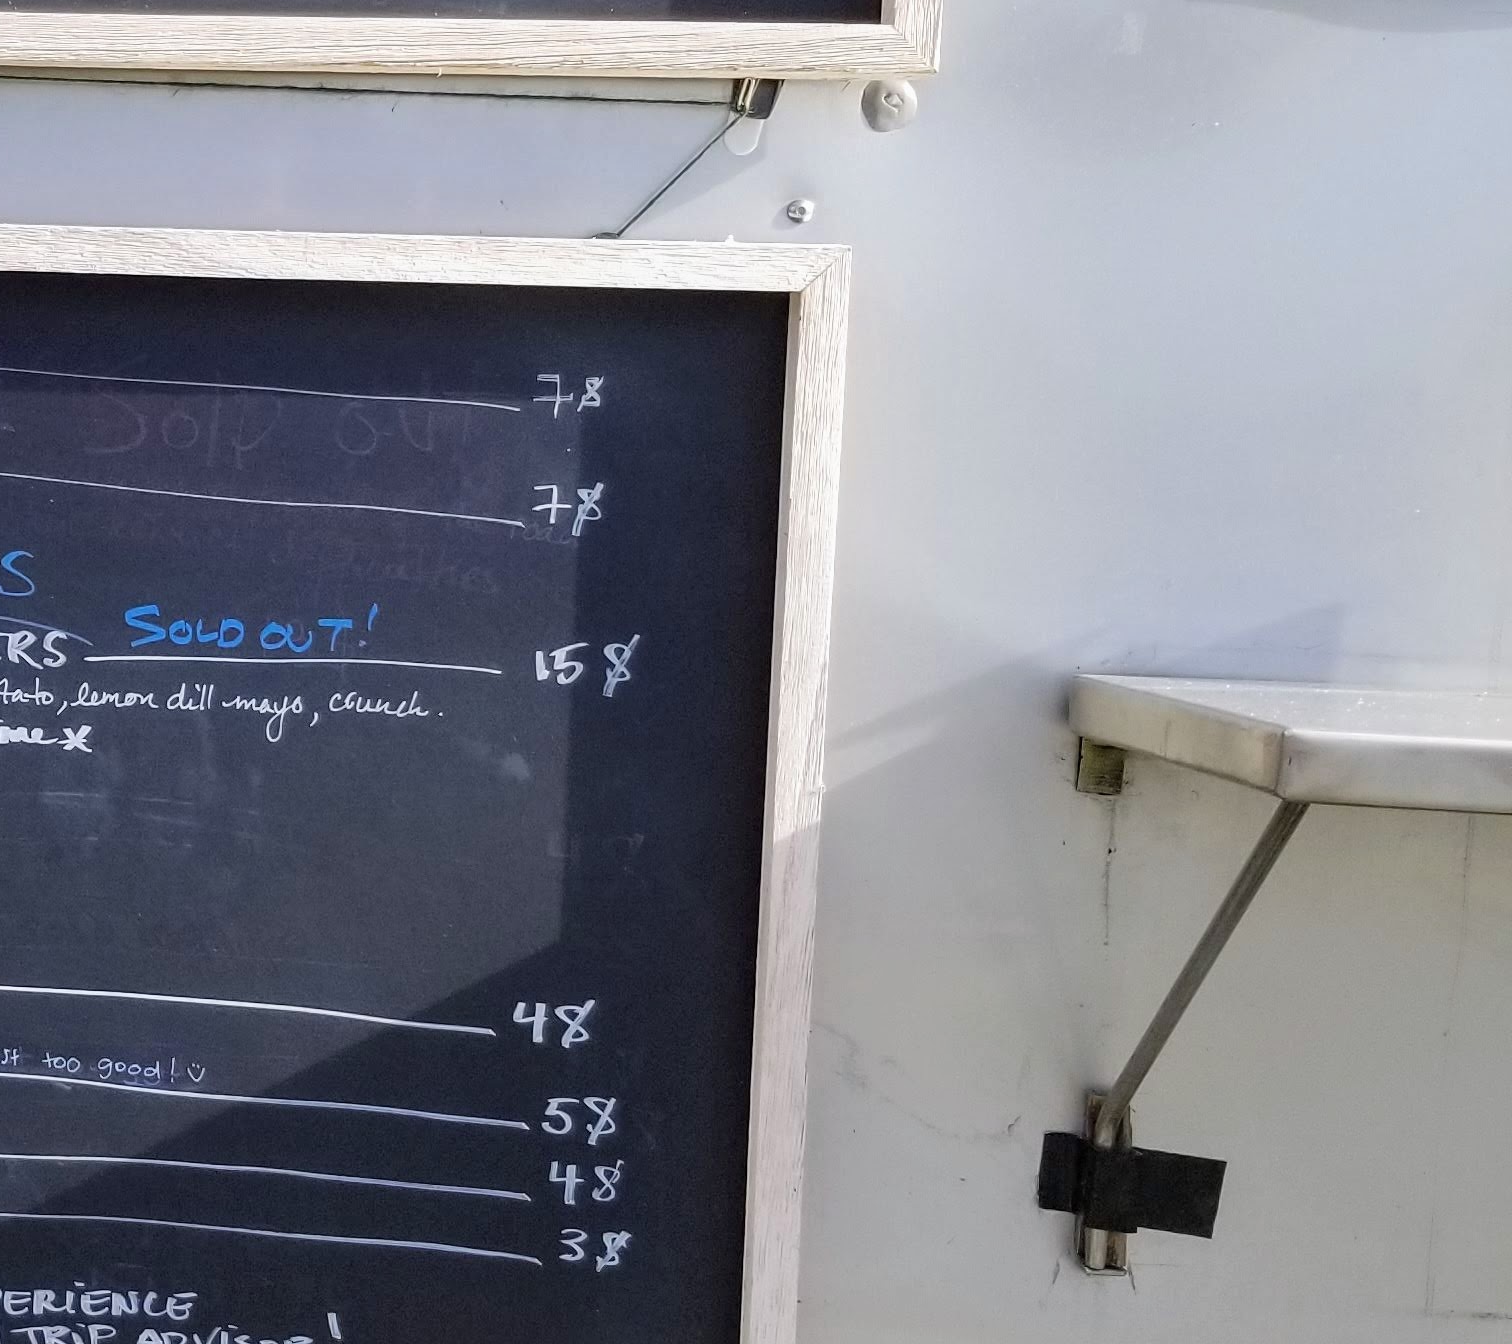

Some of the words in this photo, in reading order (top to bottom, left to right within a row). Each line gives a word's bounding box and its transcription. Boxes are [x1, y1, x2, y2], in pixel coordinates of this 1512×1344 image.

[124, 604, 245, 649] SOLD
[69, 682, 156, 709] lemon
[167, 683, 214, 711] dill
